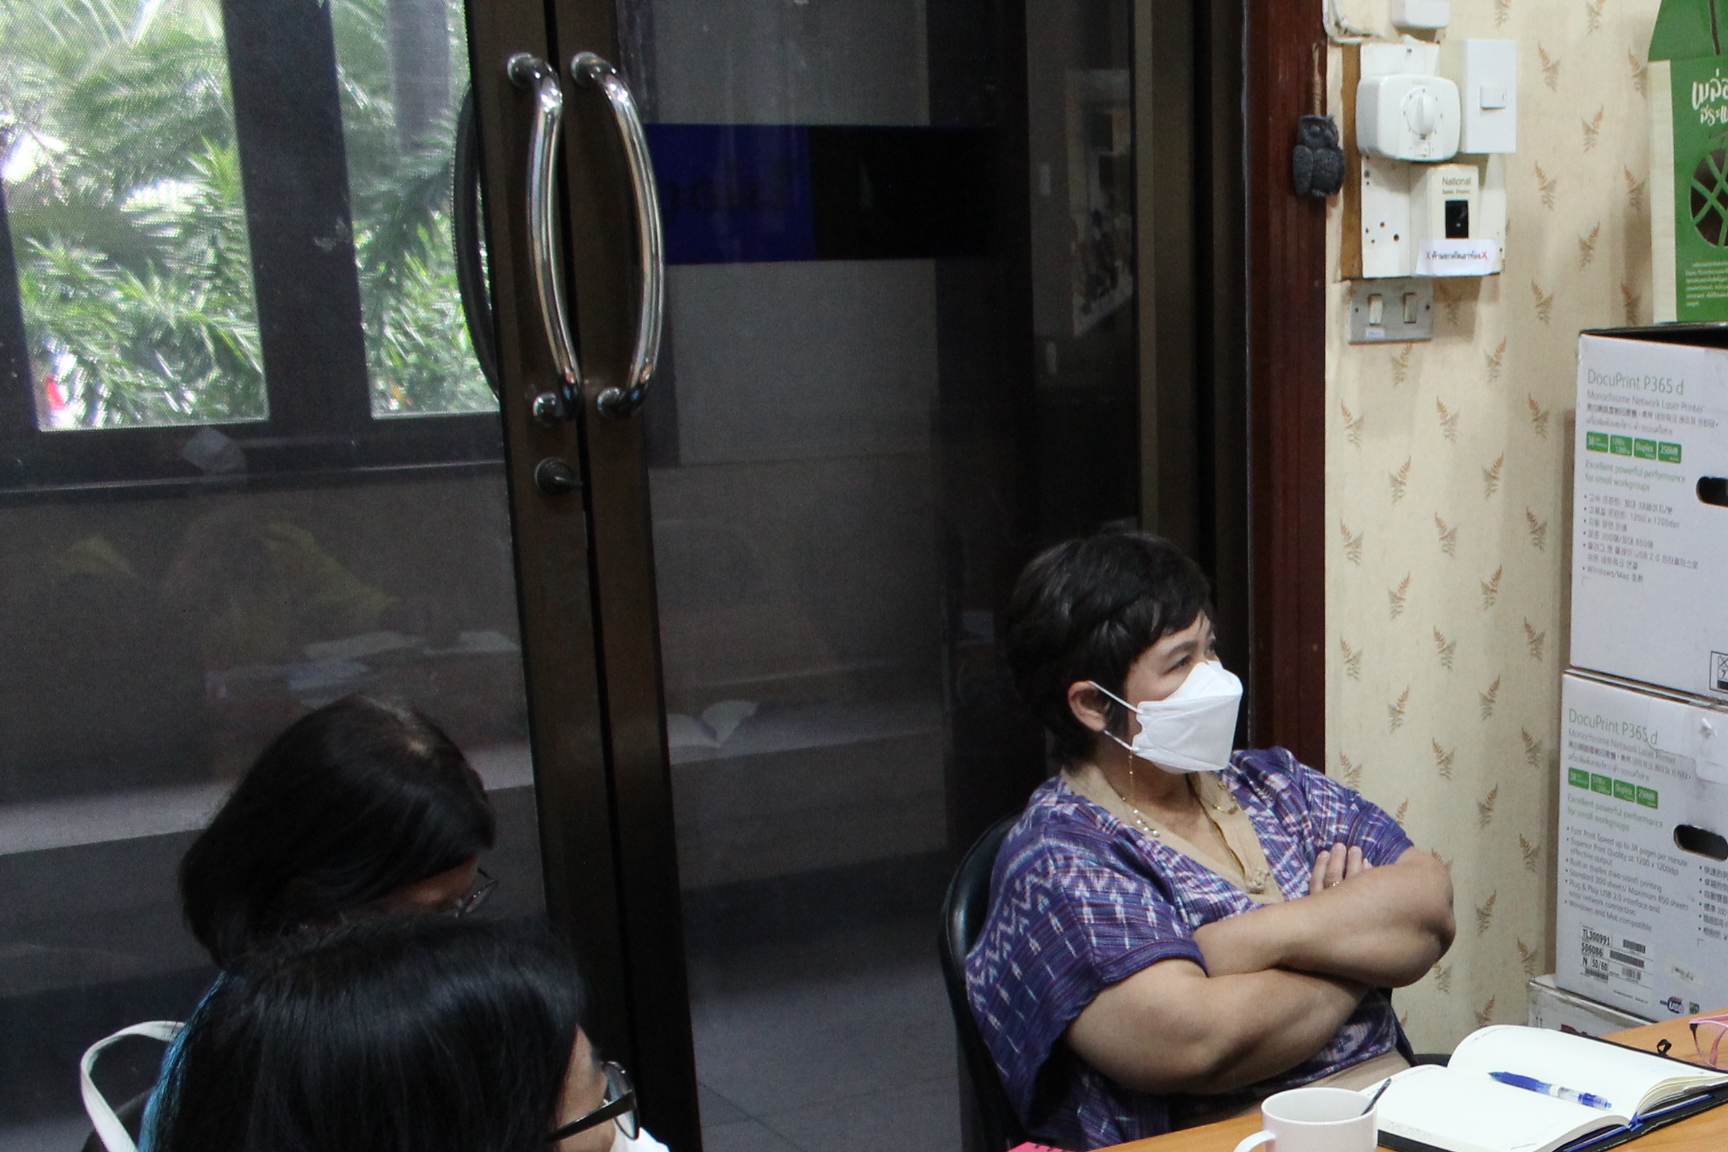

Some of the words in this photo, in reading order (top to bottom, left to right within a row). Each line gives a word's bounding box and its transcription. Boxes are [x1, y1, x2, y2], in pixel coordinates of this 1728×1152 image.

[1442, 177, 1471, 186] National
[1587, 369, 1640, 390] DocuPrint
[1643, 376, 1673, 394] P365
[1676, 380, 1684, 395] d
[1587, 390, 1632, 406] Monochrome
[1632, 395, 1660, 409] Network
[1661, 398, 1679, 411] Laser
[1680, 401, 1703, 413] Printer
[1568, 708, 1619, 735] DocuPrint
[1622, 721, 1648, 742] P365
[1650, 731, 1658, 745] d
